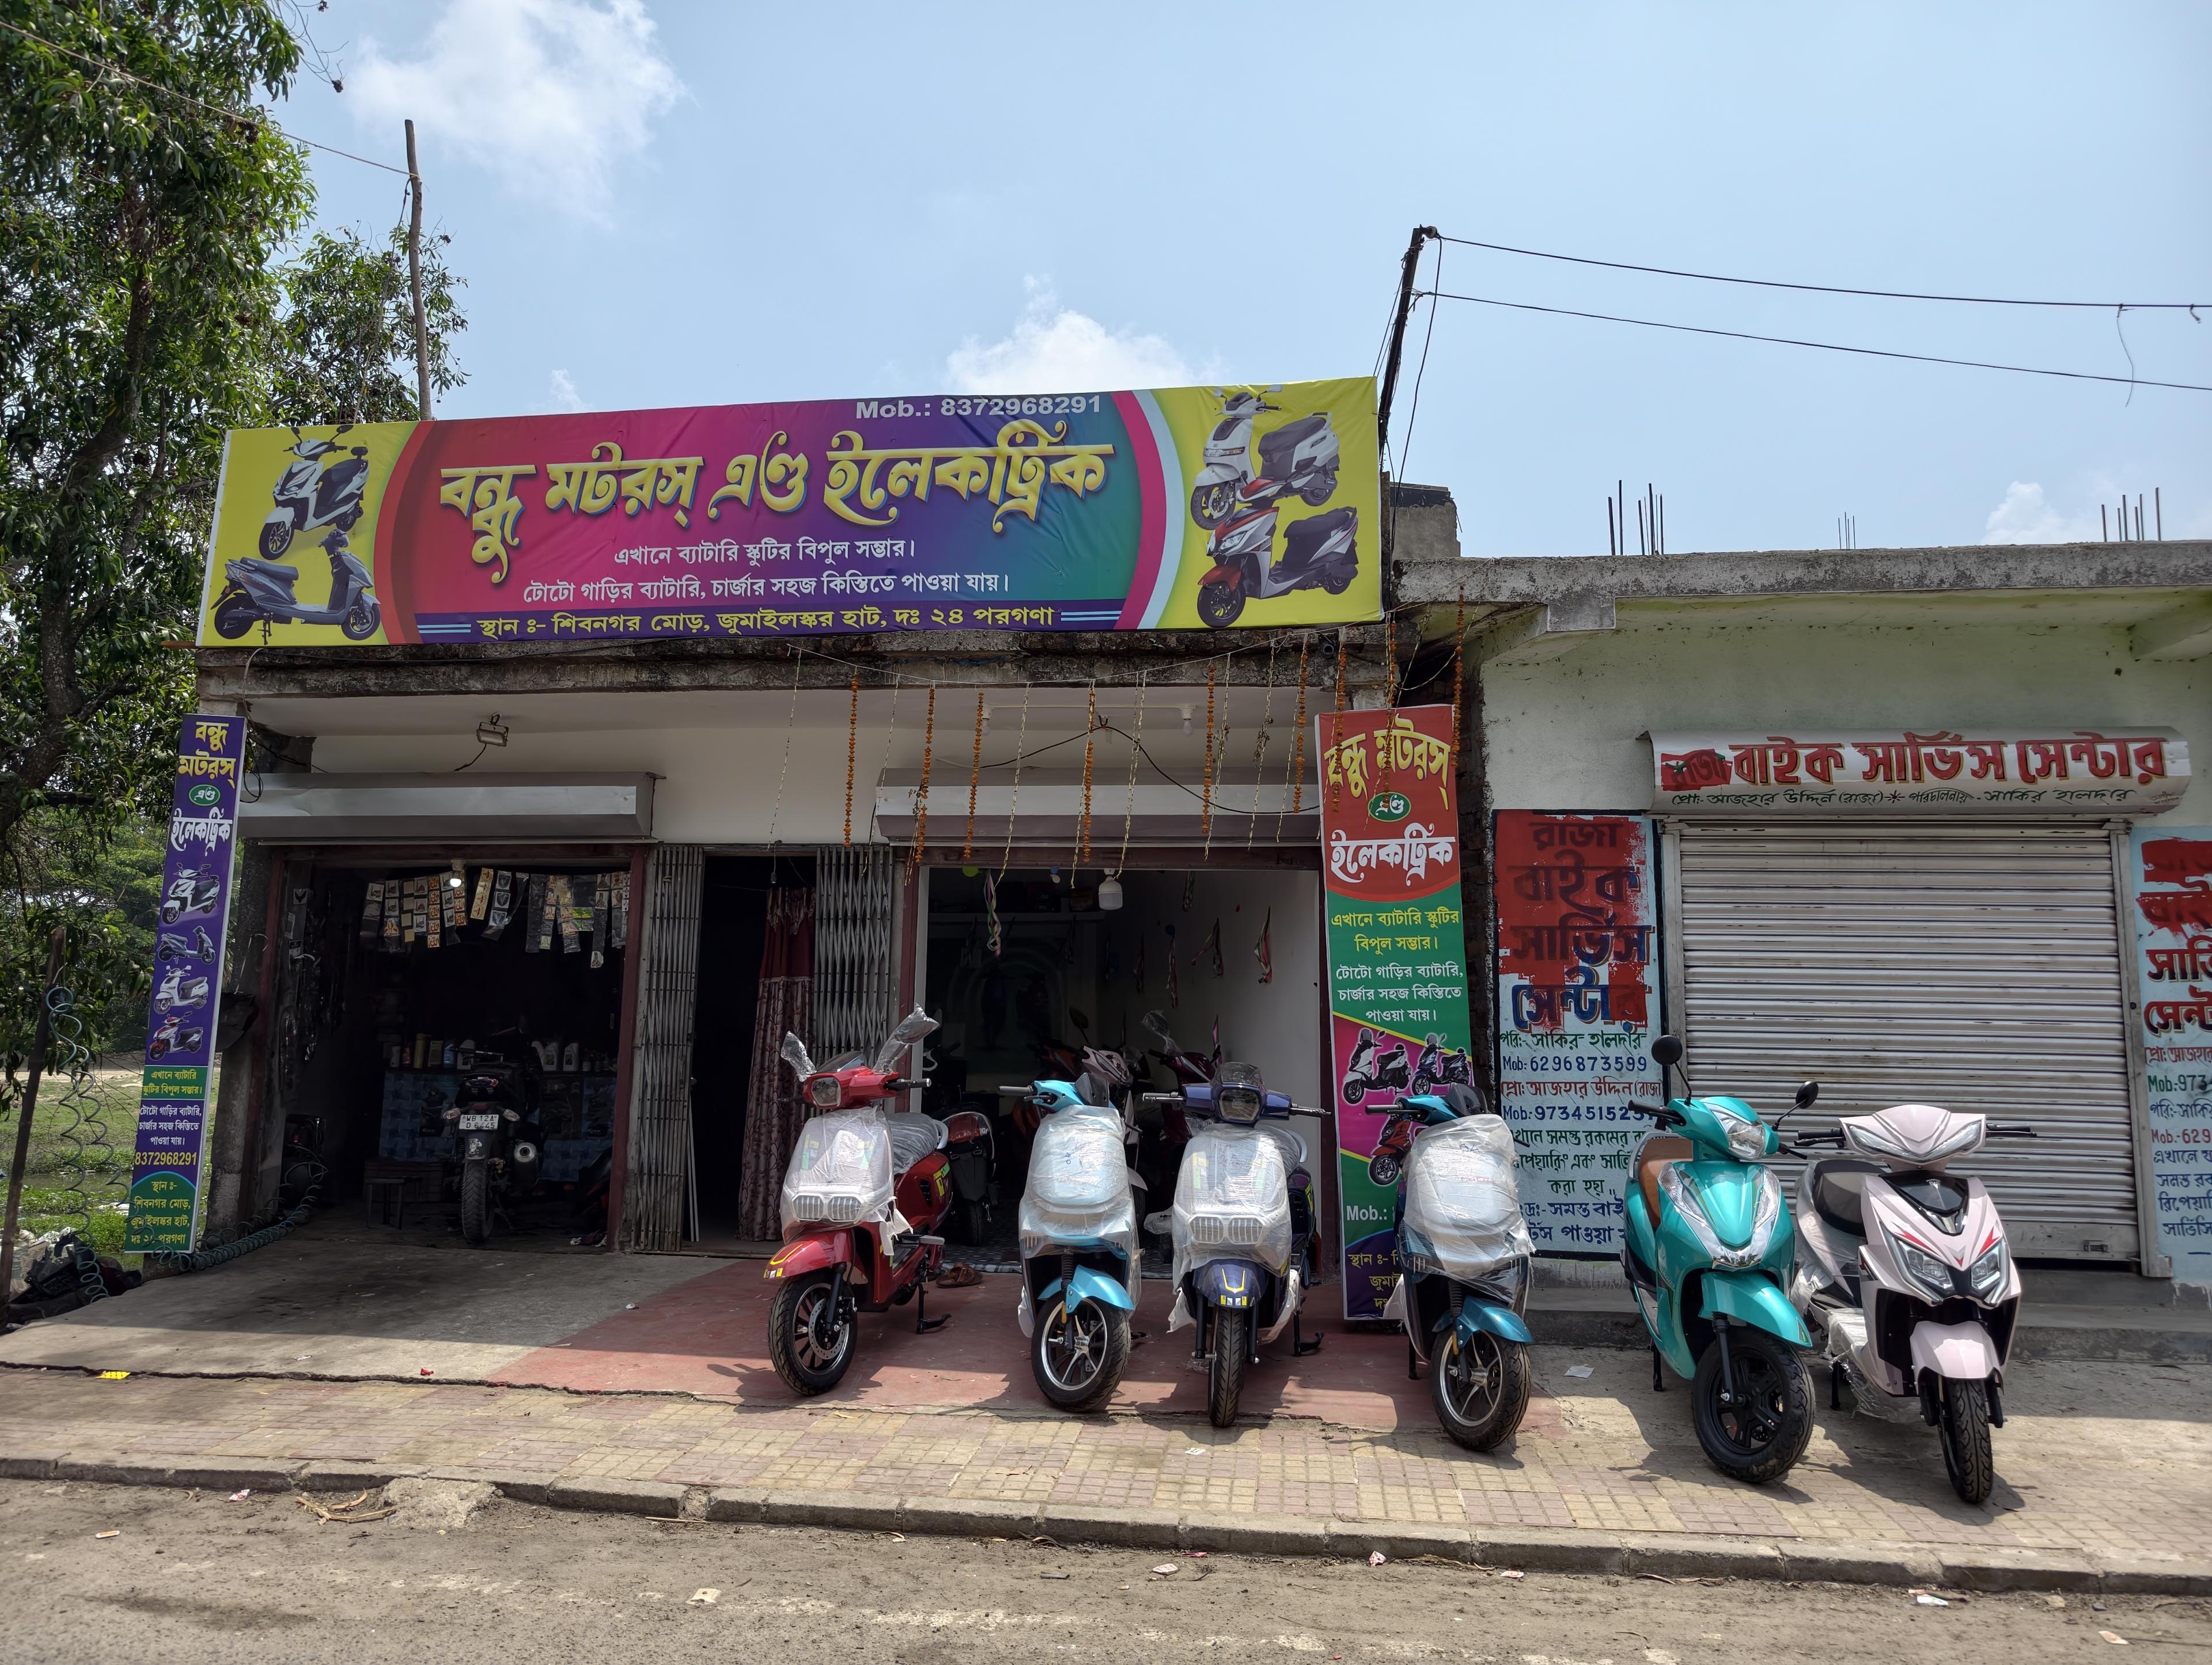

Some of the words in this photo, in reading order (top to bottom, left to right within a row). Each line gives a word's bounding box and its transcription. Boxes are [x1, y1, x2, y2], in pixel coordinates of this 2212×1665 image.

[857, 401, 932, 419] Mob.:
[941, 395, 1100, 417] 8372968291
[440, 464, 536, 583] বন্ধু
[547, 442, 703, 528] মটরস্
[824, 419, 1115, 533] ইলেকট্রিক
[615, 545, 672, 565] এখানে
[677, 538, 739, 565] ব্যাটারি
[745, 537, 791, 567] স্কুটির
[796, 536, 850, 565] বিপুল
[524, 579, 575, 602] টোটো
[581, 577, 634, 604] গাড়ির
[638, 574, 706, 600] ব্যাটারি,
[712, 573, 766, 597] চার্জার
[772, 577, 818, 597] সহজ
[821, 570, 897, 596] কিস্তিতে
[901, 571, 960, 593] পাওয়া
[476, 617, 520, 640] স্থান
[551, 612, 642, 635] শিবনগর
[651, 612, 710, 634] মোড়,
[840, 604, 887, 629] হাট,
[930, 608, 964, 625] ২৪
[973, 605, 1054, 625] পরগণা
[195, 722, 229, 755] বন্ধু
[1728, 736, 1846, 785] বাইক
[1851, 731, 2008, 784] সার্ভিস
[2016, 731, 2169, 785] সেন্টার
[178, 749, 236, 789] মটরস্
[1324, 733, 1369, 802] বন্ধু
[1706, 793, 1779, 807] আজহার
[1783, 789, 1836, 806] উদ্দিন
[1909, 787, 1975, 804] পরিচালনায়
[1984, 787, 2047, 803] সাকির
[2053, 789, 2137, 805] হালদার
[171, 806, 233, 857] ইলেকট্রিক
[1330, 822, 1456, 886] ইলেকট্রিক
[1331, 912, 1373, 927] এখানে
[1376, 907, 1422, 926] ব্যাটারি
[1425, 906, 1460, 929] স্কুটির
[1354, 934, 1392, 955] বিপুল
[1336, 963, 1372, 980] টোটো
[1376, 962, 1412, 980] গাড়ির
[1415, 961, 1463, 978] ব্যাটারি,
[1338, 985, 1374, 1001] চার্জার
[1377, 988, 1410, 1001] সহজ
[1411, 983, 1463, 1000] কিস্তিতে
[1365, 1008, 1404, 1022] পাওয়া
[1531, 1028, 1585, 1050] সাকির
[1588, 1030, 1647, 1056] হালদার
[1531, 1056, 1647, 1071] 6296873599
[151, 1069, 172, 1080] এখানে
[175, 1069, 197, 1080] ব্যাটারি
[161, 1083, 180, 1096] বিপুল
[1526, 1081, 1589, 1104] আজহার
[1590, 1076, 1634, 1105] উদ্দিন
[140, 1105, 158, 1116] টোটো
[159, 1104, 178, 1117] গাড়ির
[138, 1119, 157, 1131] চার্জার
[158, 1122, 173, 1132] সহজ
[175, 1120, 200, 1131] কিস্তিতে
[150, 1136, 169, 1146] পাওয়া
[1546, 1130, 1581, 1146] সমস্ত
[1582, 1131, 1631, 1148] রকমের
[135, 1152, 197, 1165] 8372968291
[1571, 1154, 1596, 1170] এবং
[2154, 1150, 2198, 1164] এখানে
[151, 1181, 168, 1193] স্থান
[1547, 1179, 1576, 1197] করা
[2156, 1174, 2191, 1188] সমস্ত
[134, 1196, 166, 1209] শিবনগর
[1547, 1202, 1590, 1218] সমস্ত
[1347, 1205, 1387, 1220] Mob.:
[158, 1233, 186, 1245] পরগণা
[1561, 1224, 1614, 1244] পাওয়া
[1347, 1253, 1373, 1269] স্থান
